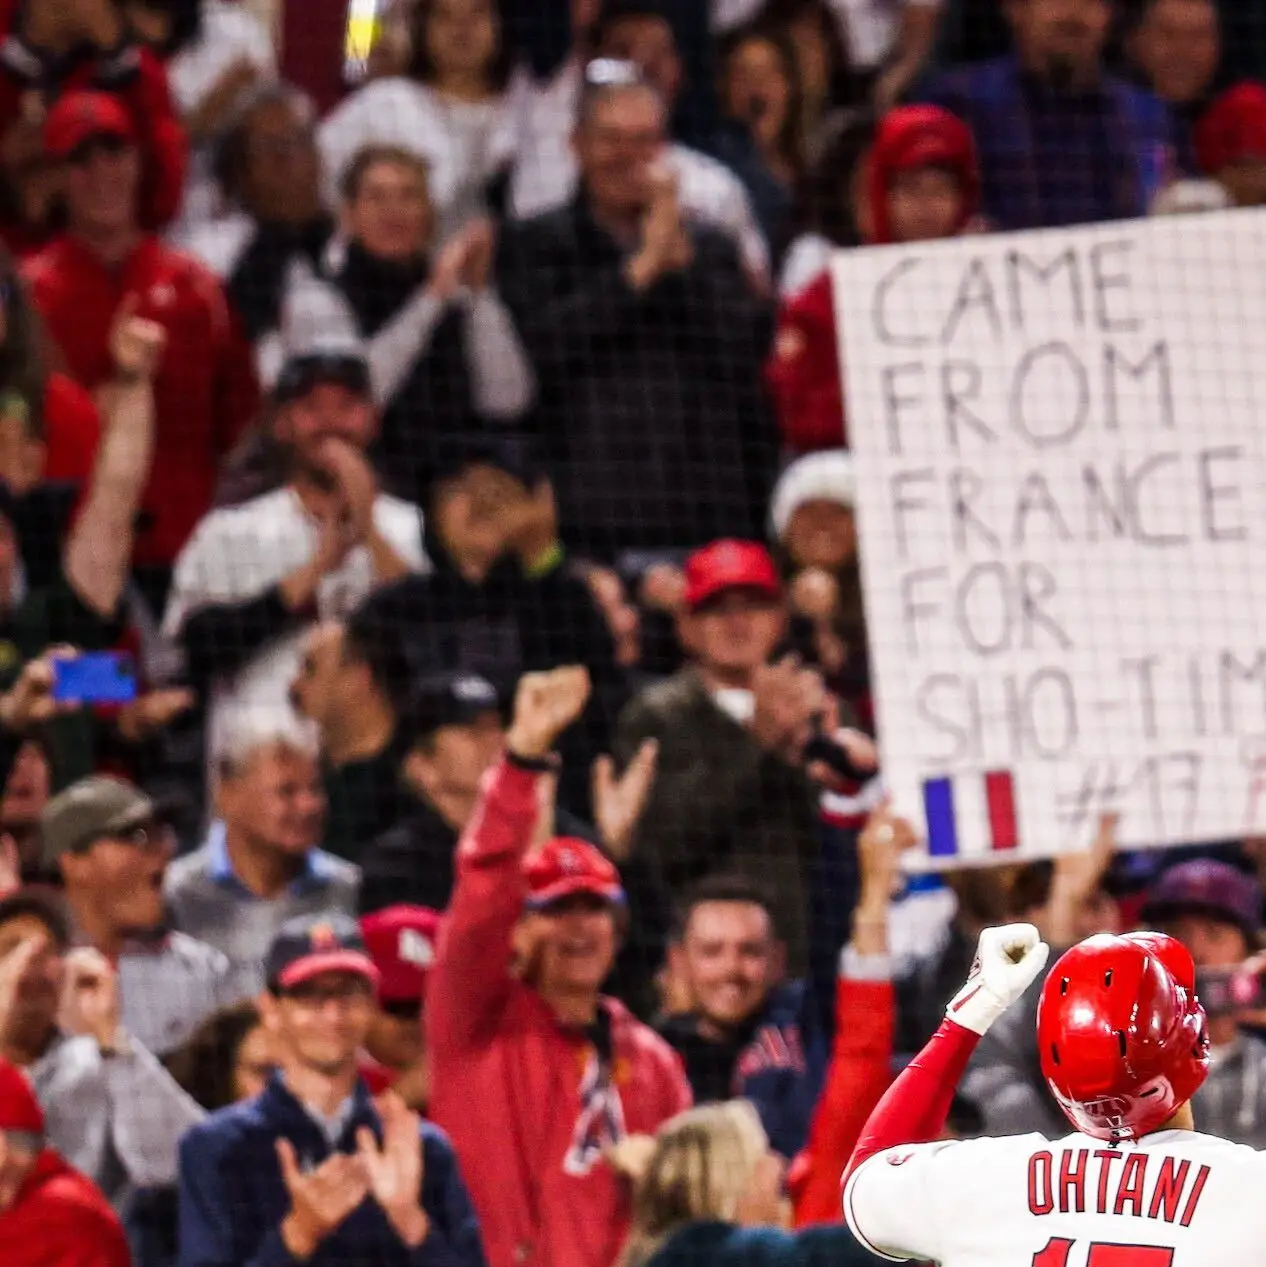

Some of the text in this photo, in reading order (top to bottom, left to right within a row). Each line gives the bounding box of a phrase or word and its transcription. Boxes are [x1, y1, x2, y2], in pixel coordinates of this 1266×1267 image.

[871, 240, 1140, 345] CAME
[881, 340, 1175, 456] FROM
[891, 446, 1247, 559] FRANCE
[902, 561, 1073, 656] FOR
[1028, 1149, 1211, 1227] OHTANI
